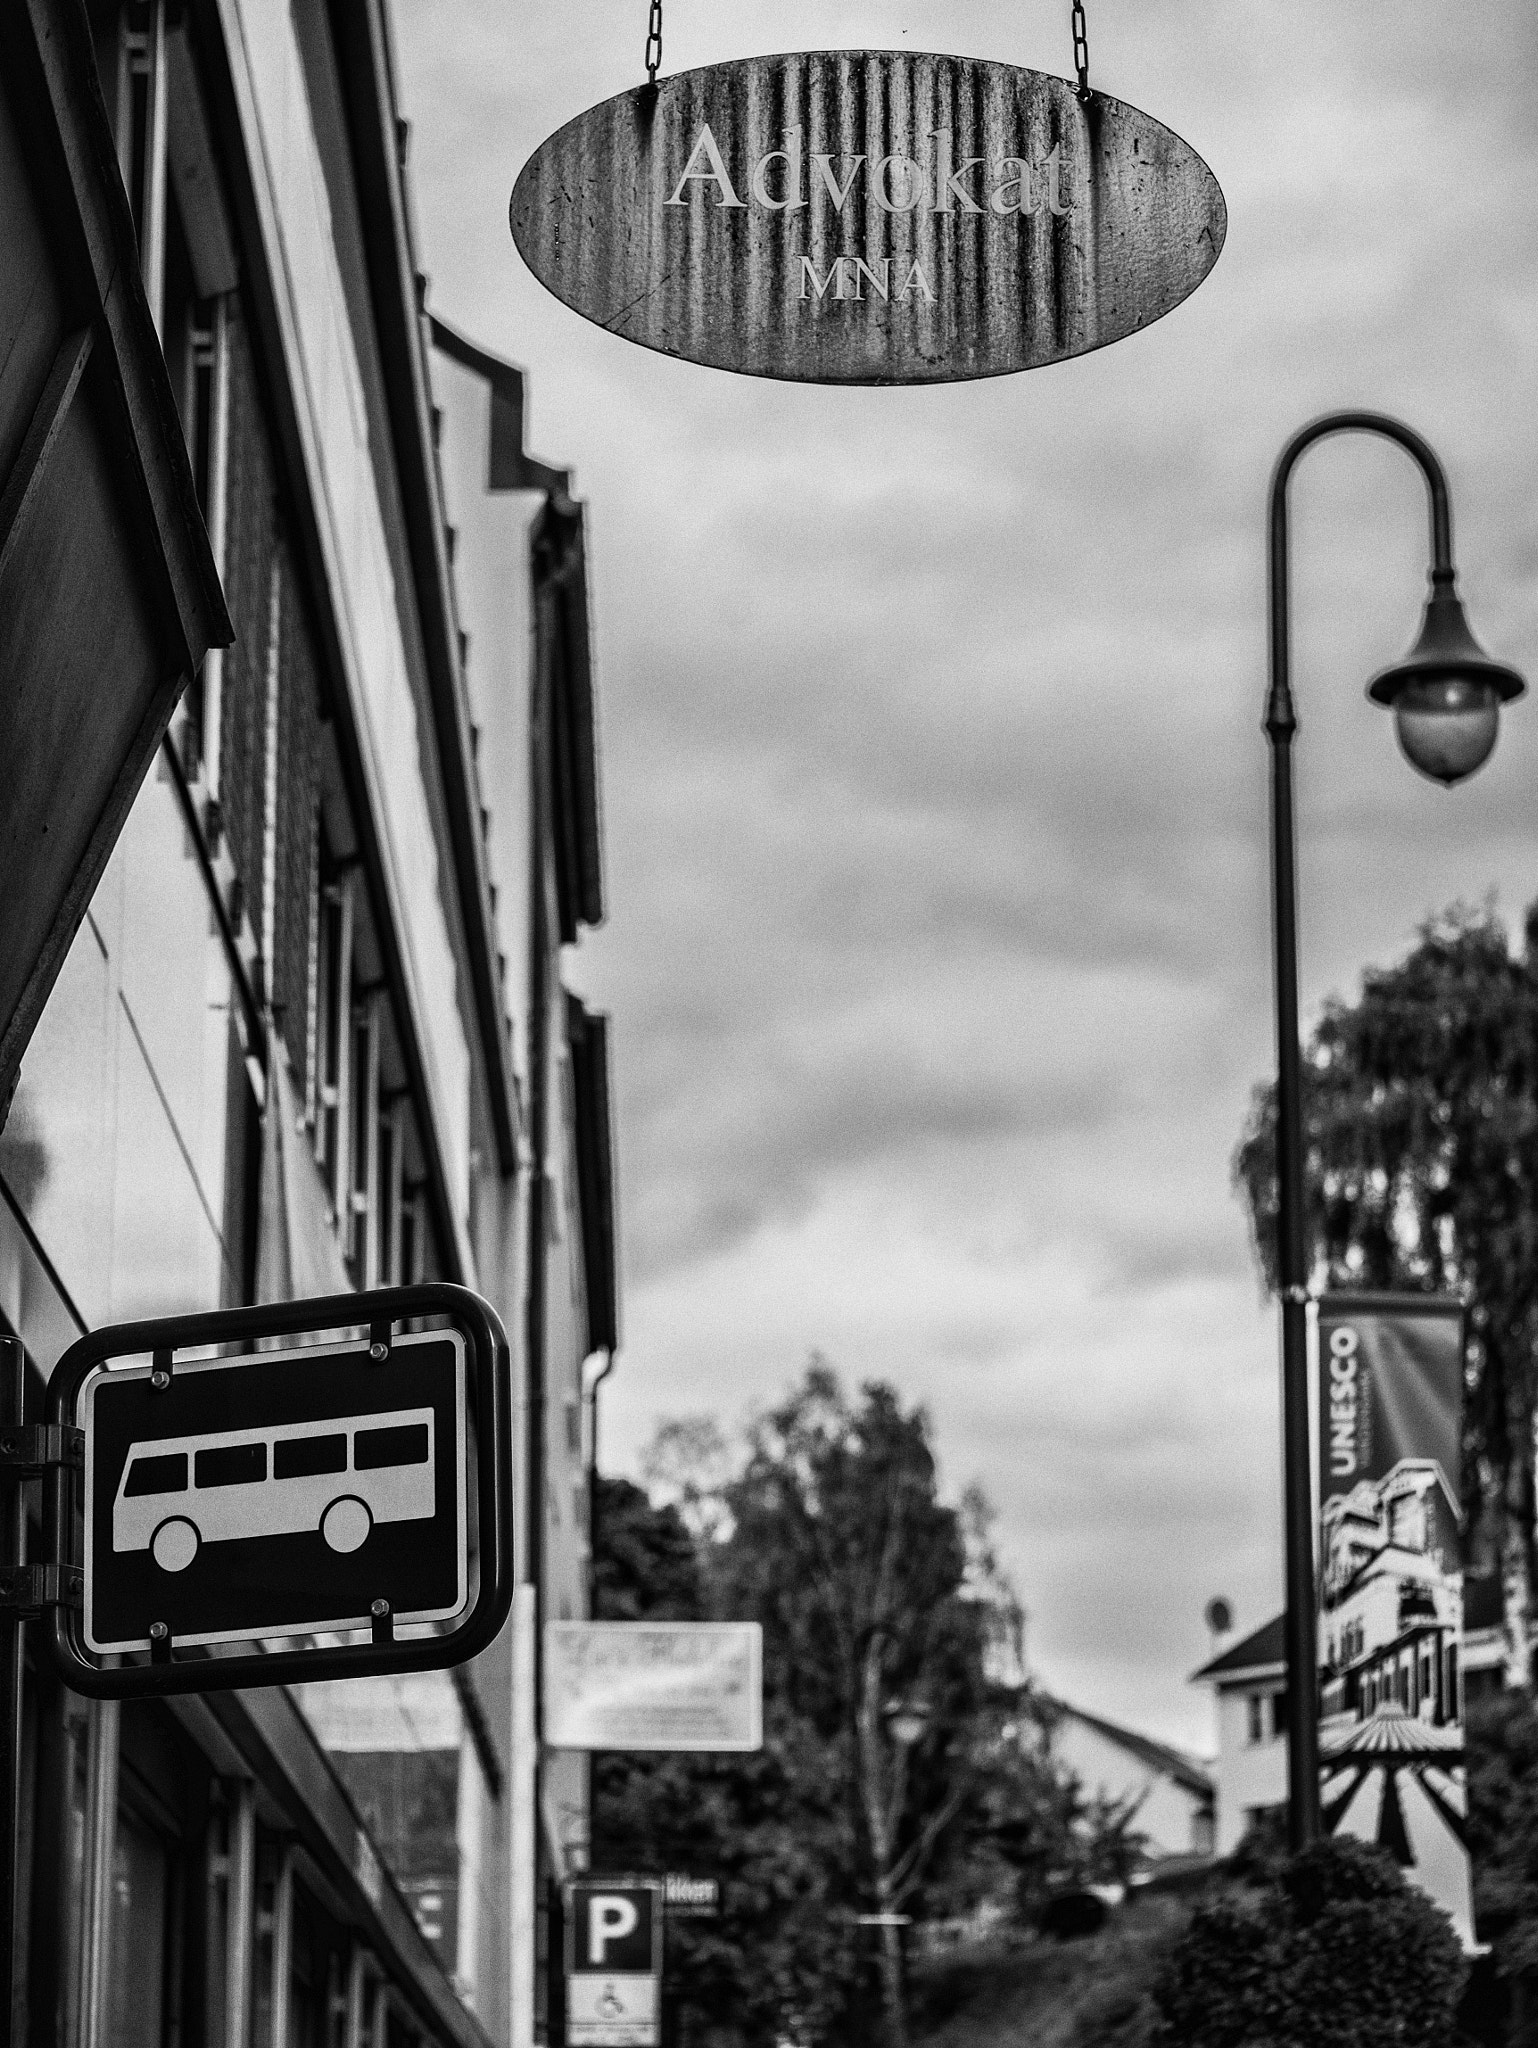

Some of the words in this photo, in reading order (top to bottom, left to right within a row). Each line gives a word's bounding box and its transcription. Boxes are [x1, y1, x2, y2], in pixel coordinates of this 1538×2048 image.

[662, 122, 1075, 216] Advokat
[797, 255, 939, 302] MNA
[1329, 1327, 1358, 1477] UNESCO
[589, 1895, 638, 1964] P
